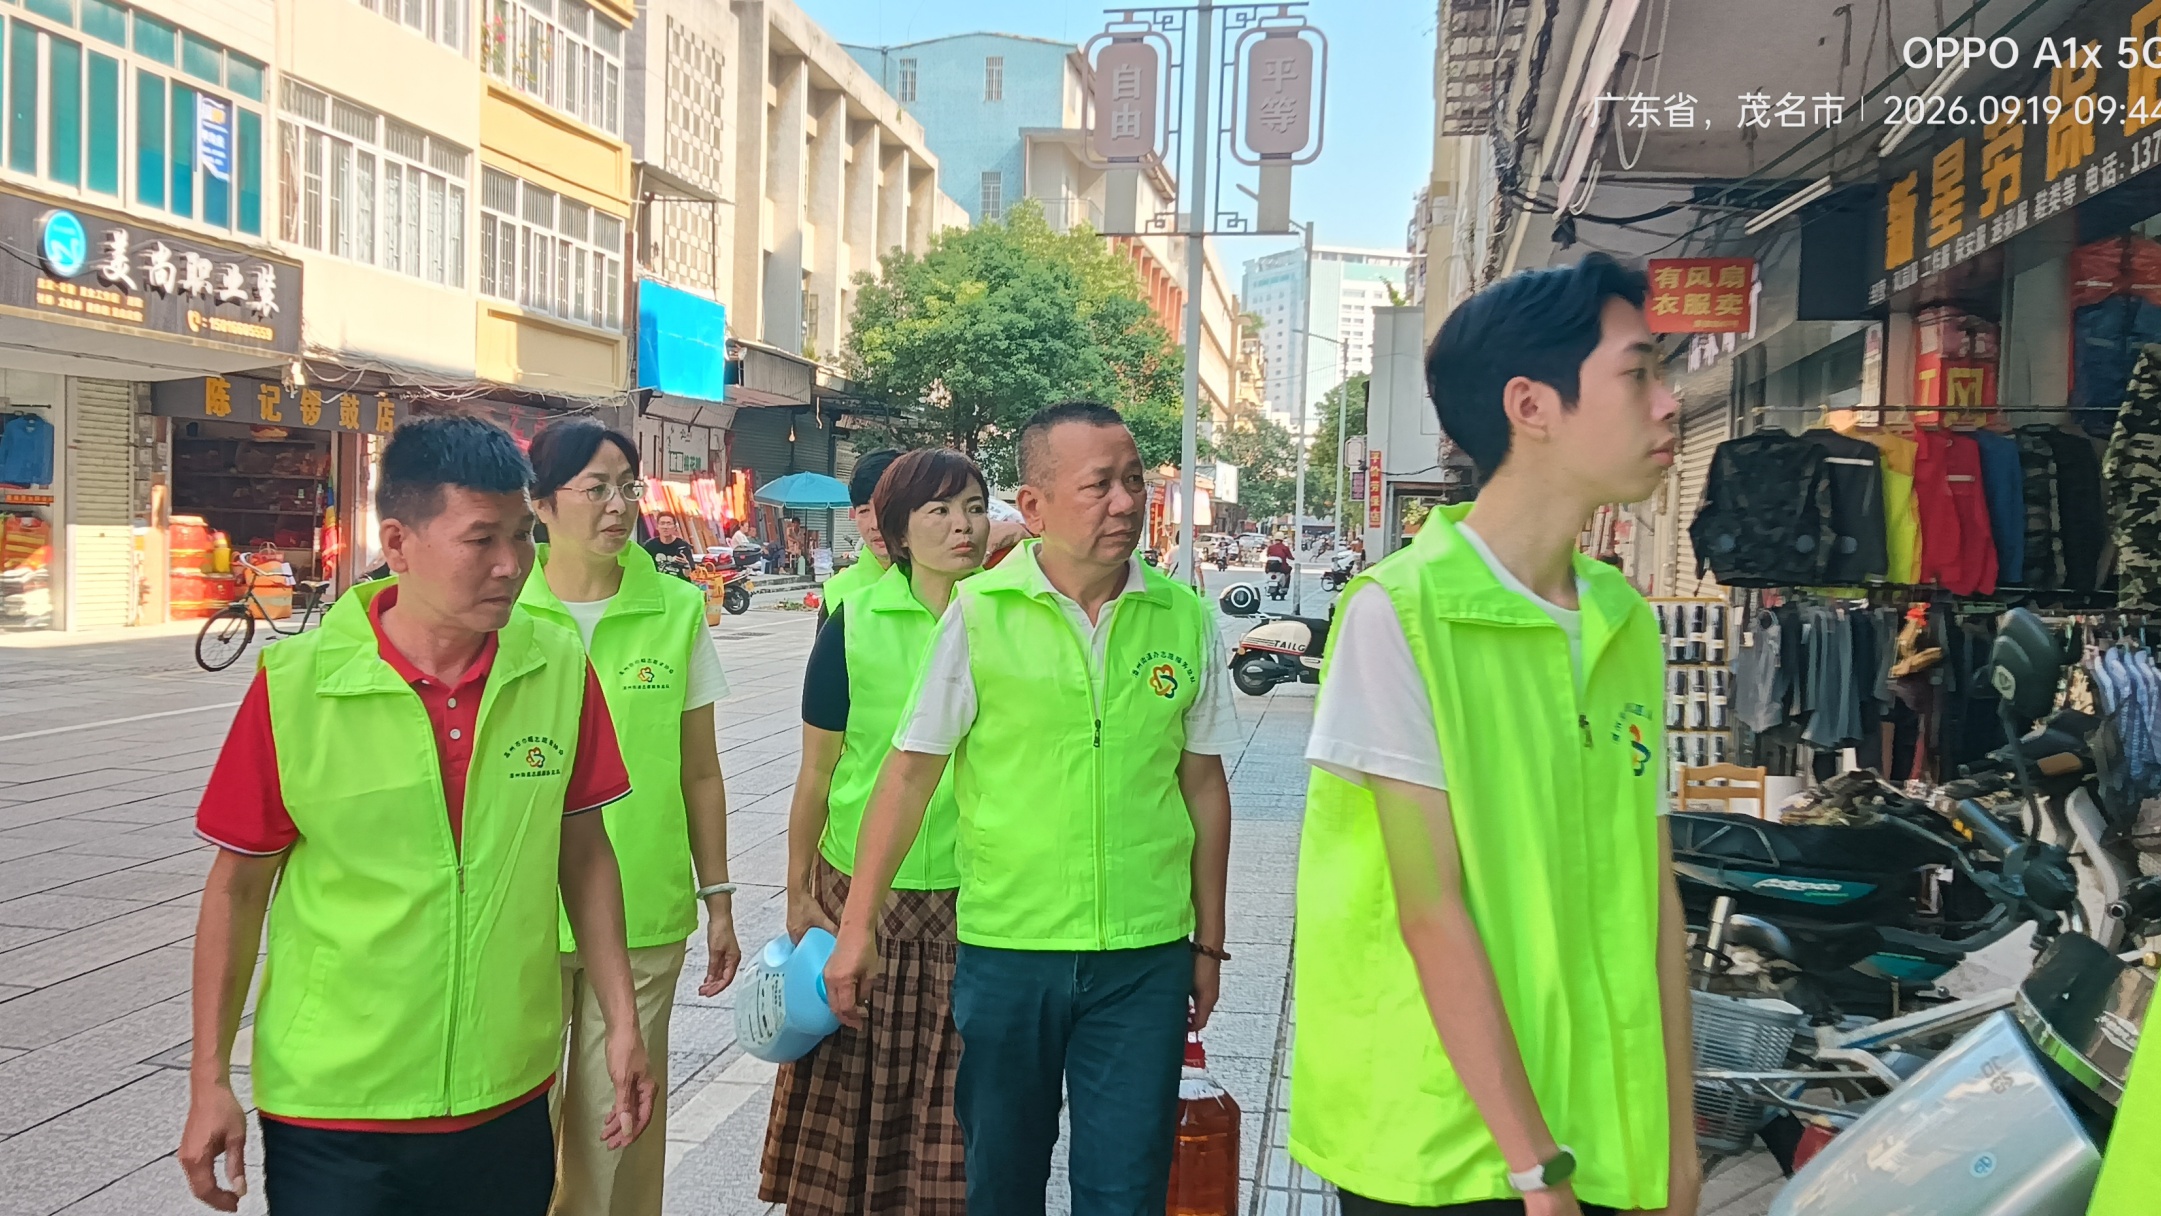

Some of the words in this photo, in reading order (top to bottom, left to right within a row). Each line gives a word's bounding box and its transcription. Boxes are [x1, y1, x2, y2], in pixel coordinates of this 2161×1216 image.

[1111, 63, 1142, 141] 自由
[1260, 56, 1299, 134] 平等
[98, 227, 280, 317] 美尚职业装
[1654, 265, 1746, 289] 有风扇
[1651, 293, 1744, 316] 衣服卖
[1274, 640, 1306, 652] TAILG
